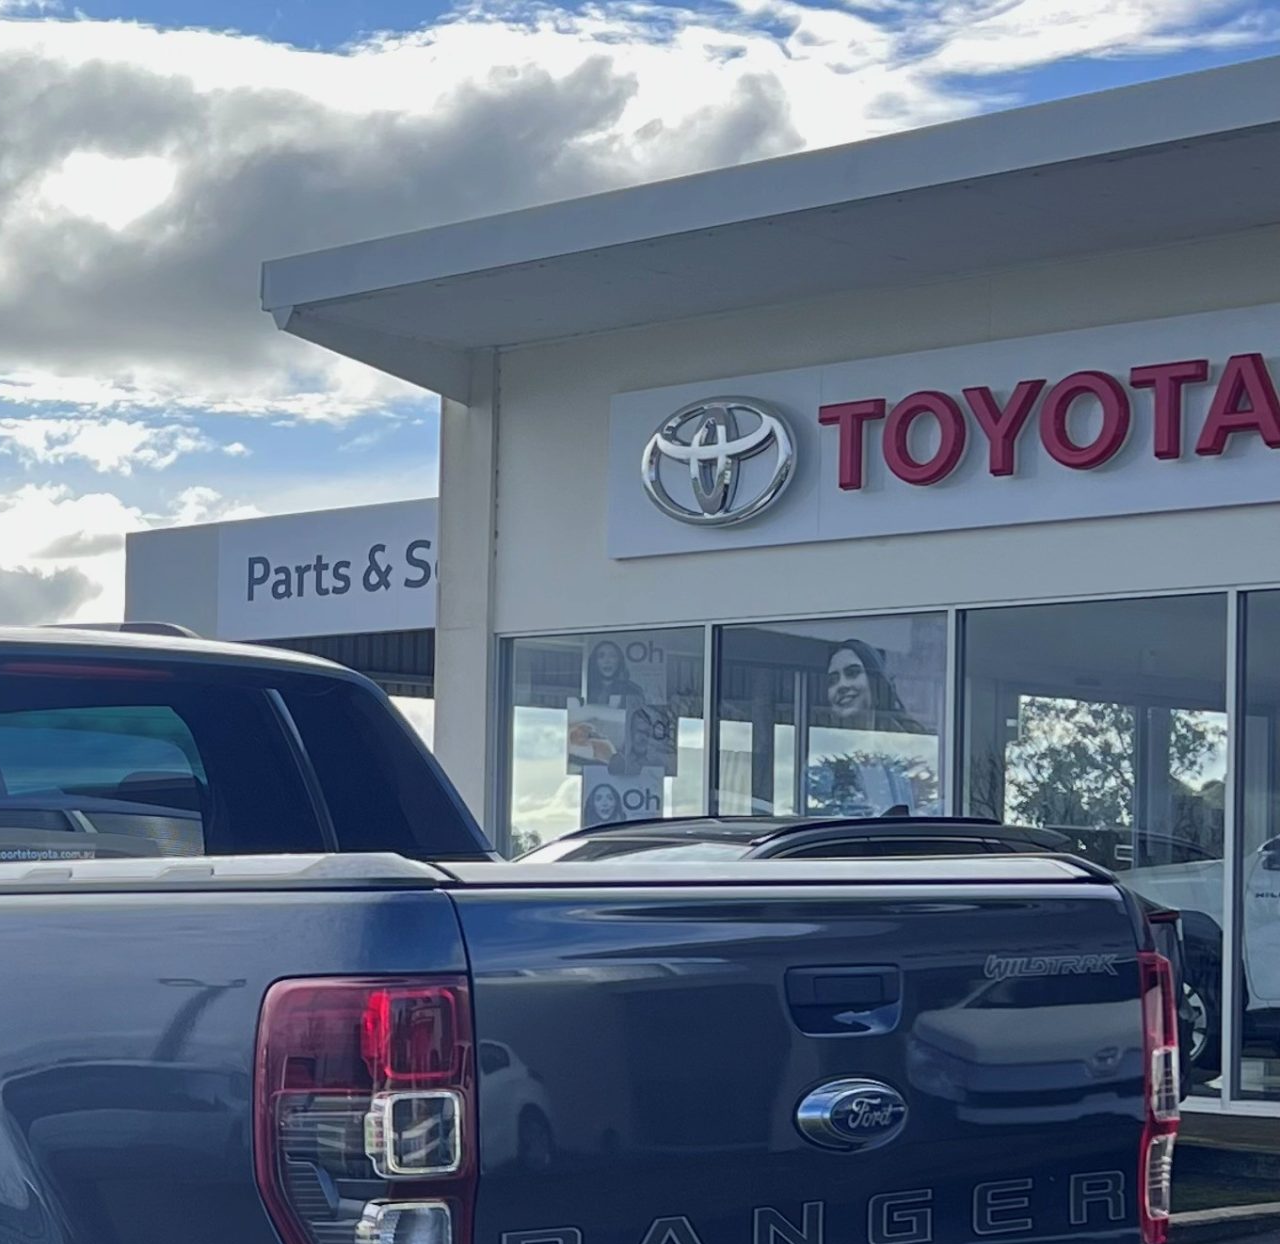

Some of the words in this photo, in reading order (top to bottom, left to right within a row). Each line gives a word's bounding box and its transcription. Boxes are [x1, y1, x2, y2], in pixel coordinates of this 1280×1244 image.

[818, 352, 1280, 491] TOYOTA
[247, 554, 351, 601] Parts
[362, 543, 393, 592] &
[404, 539, 438, 589] S
[625, 640, 663, 663] Oh
[623, 788, 660, 811] Oh
[984, 954, 1118, 981] WILDTRAK
[846, 1097, 905, 1129] Ford
